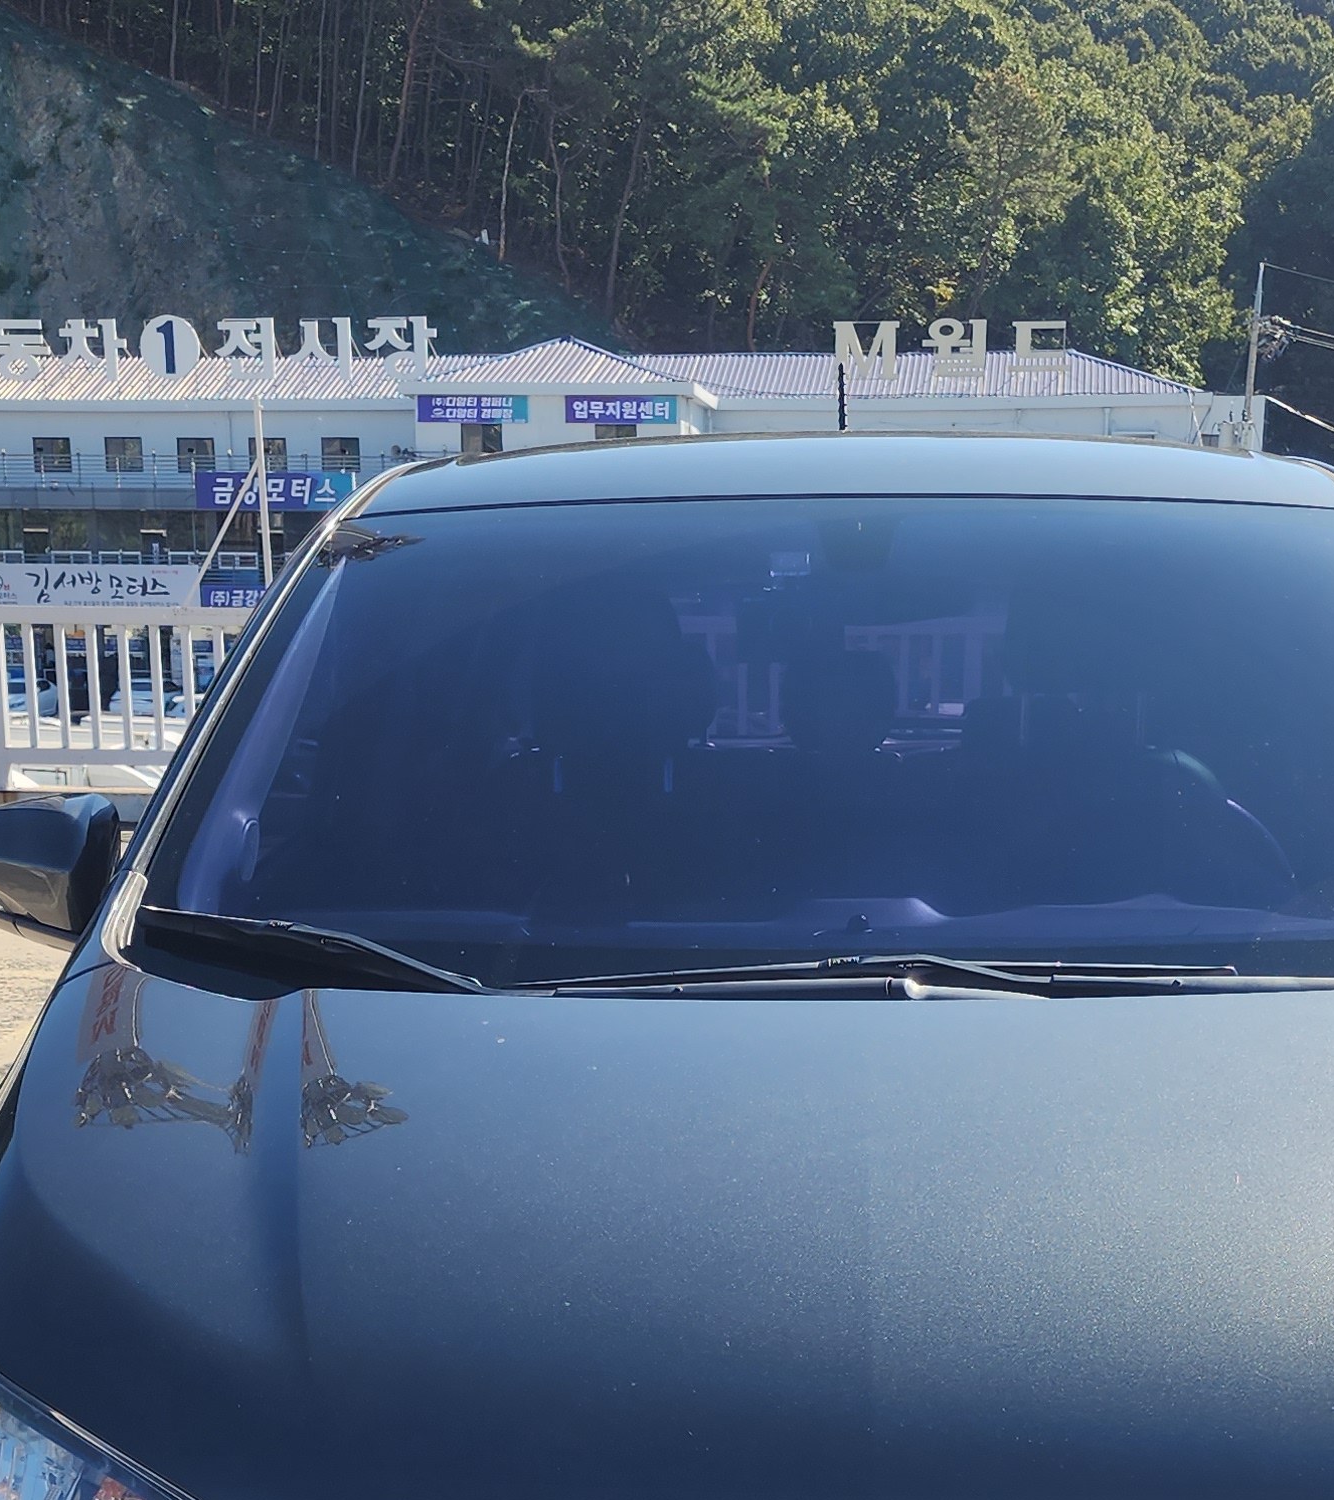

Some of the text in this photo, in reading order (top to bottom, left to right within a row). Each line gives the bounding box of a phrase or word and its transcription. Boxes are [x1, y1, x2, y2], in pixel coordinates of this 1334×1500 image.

[572, 401, 670, 420] 업무지원센터
[25, 567, 102, 604] 김서방
[210, 590, 266, 607] (주)금강
